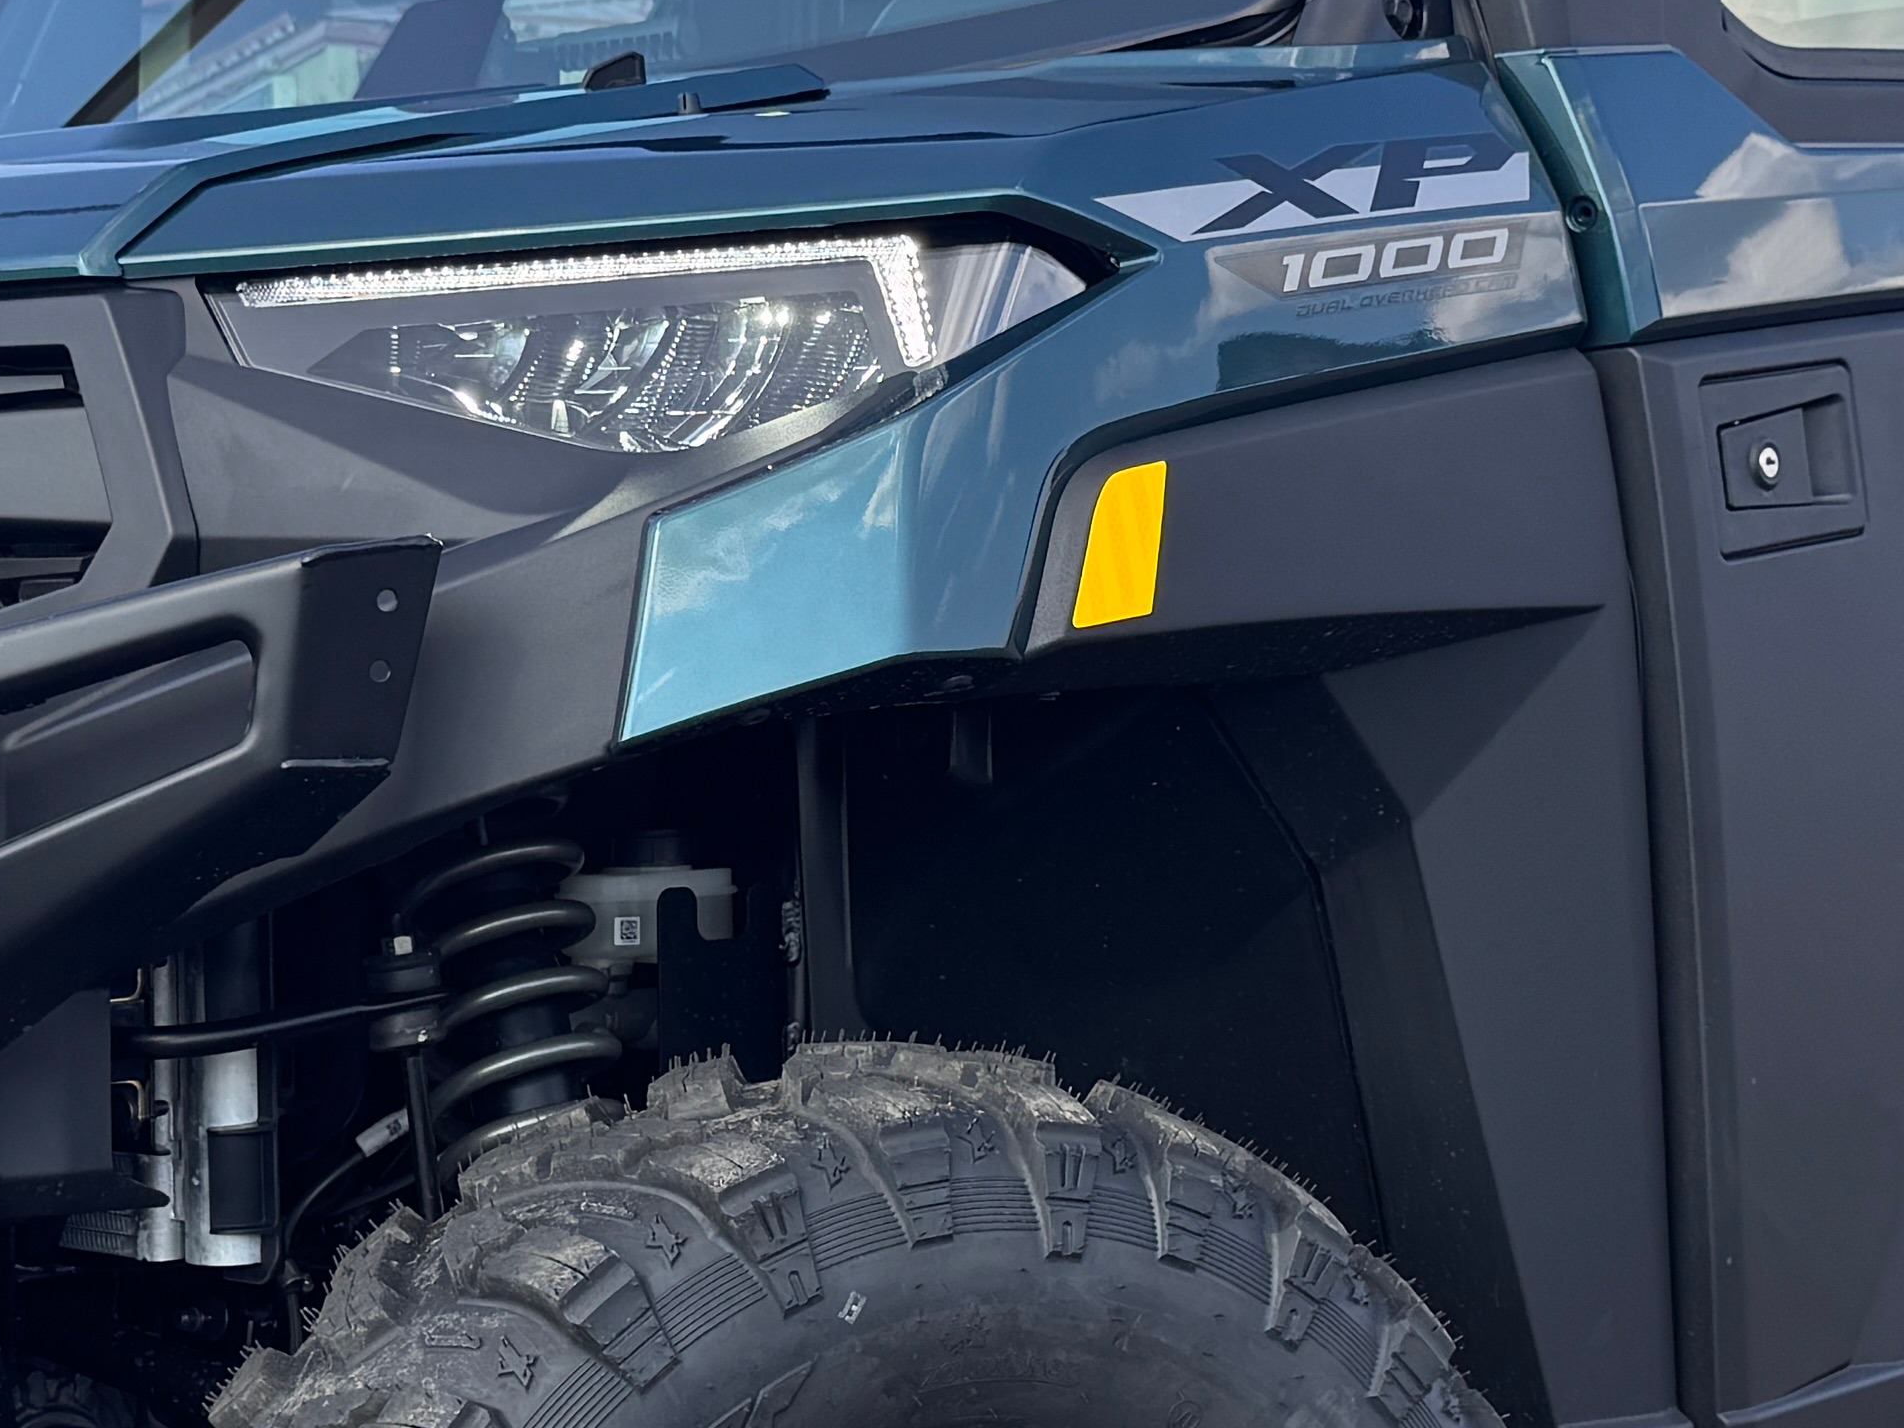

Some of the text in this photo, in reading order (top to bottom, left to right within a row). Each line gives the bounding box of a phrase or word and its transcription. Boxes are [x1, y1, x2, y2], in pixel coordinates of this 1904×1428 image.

[1191, 134, 1519, 235] XP
[1280, 228, 1509, 293] 1000
[1296, 297, 1354, 318] DUAL
